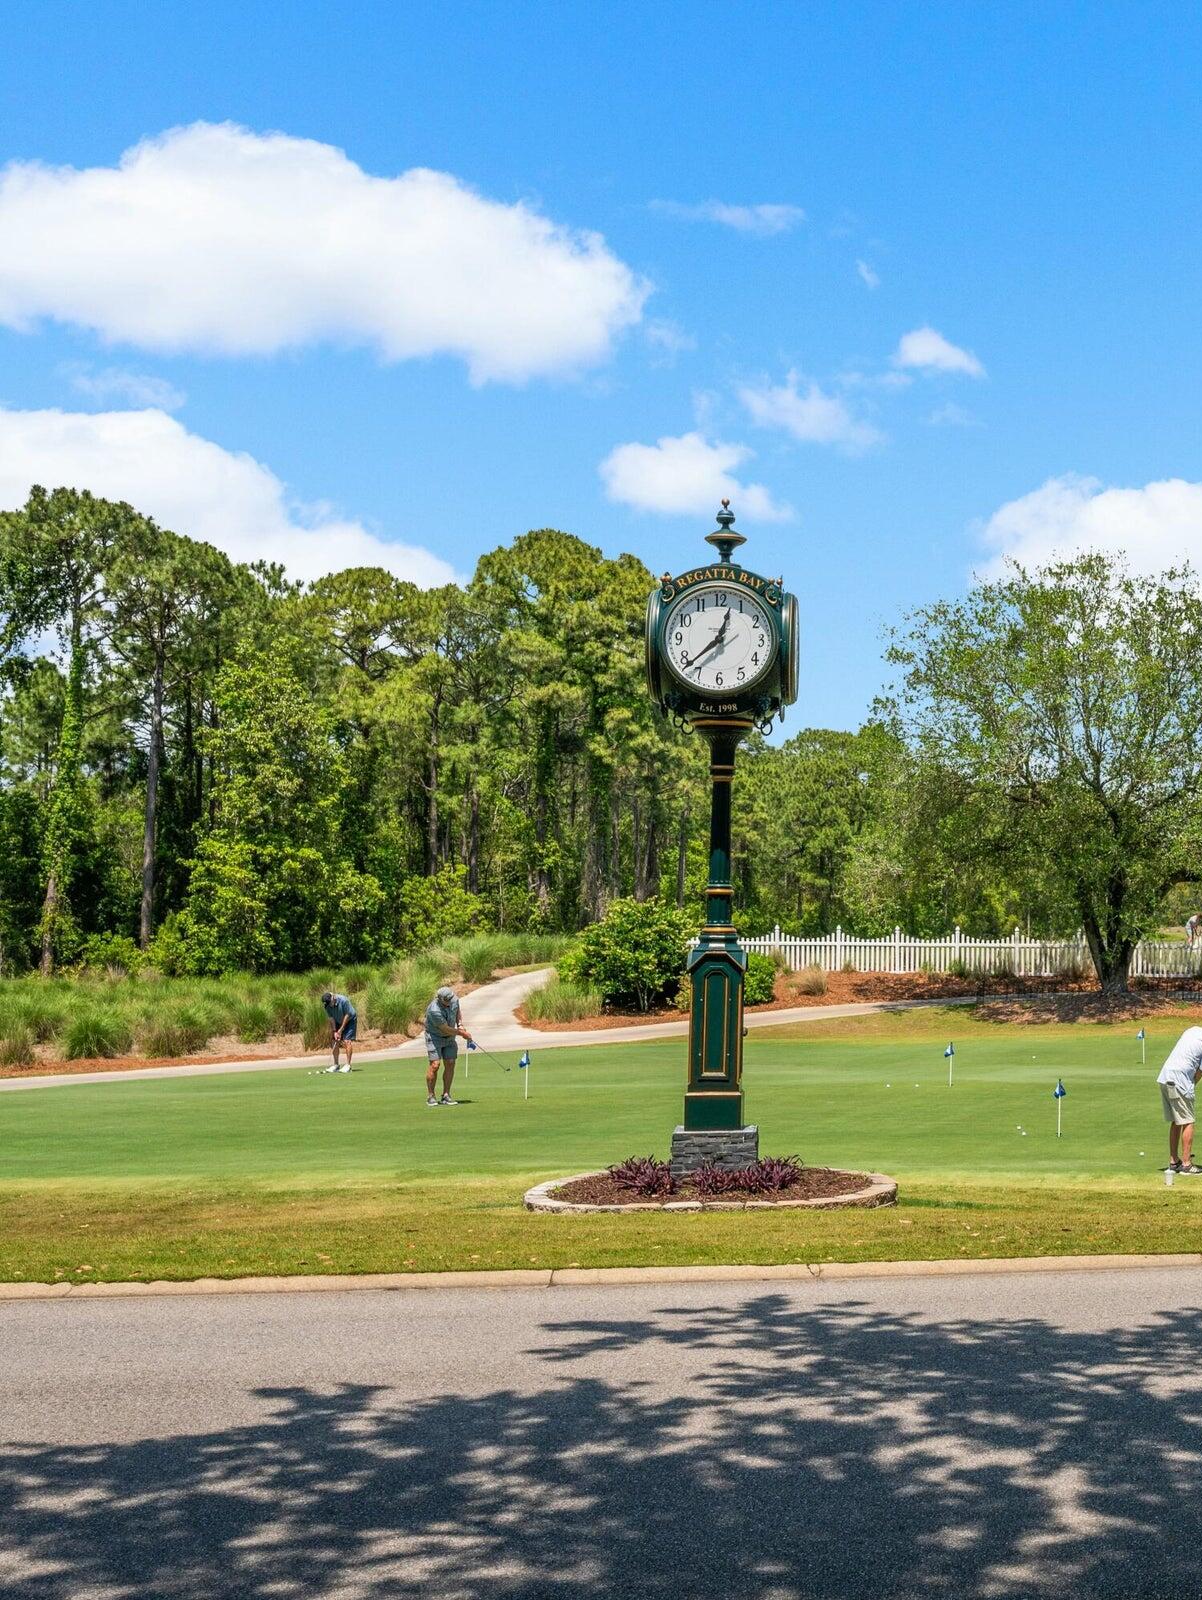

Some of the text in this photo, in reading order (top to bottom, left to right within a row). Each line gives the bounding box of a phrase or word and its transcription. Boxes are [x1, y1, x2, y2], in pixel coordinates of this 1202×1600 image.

[676, 568, 765, 589] REGATTA BAY
[697, 598, 705, 612] 11
[714, 593, 727, 607] 12
[739, 600, 743, 613] 1
[680, 613, 691, 627] 10
[752, 615, 759, 629] 2
[675, 632, 683, 645] 9
[758, 634, 765, 647] 3
[680, 650, 689, 664] 8
[751, 652, 759, 665] 4
[694, 666, 702, 680] 7
[715, 672, 723, 685] 6
[737, 667, 745, 680] 5
[699, 702, 738, 713] Est. 1998
